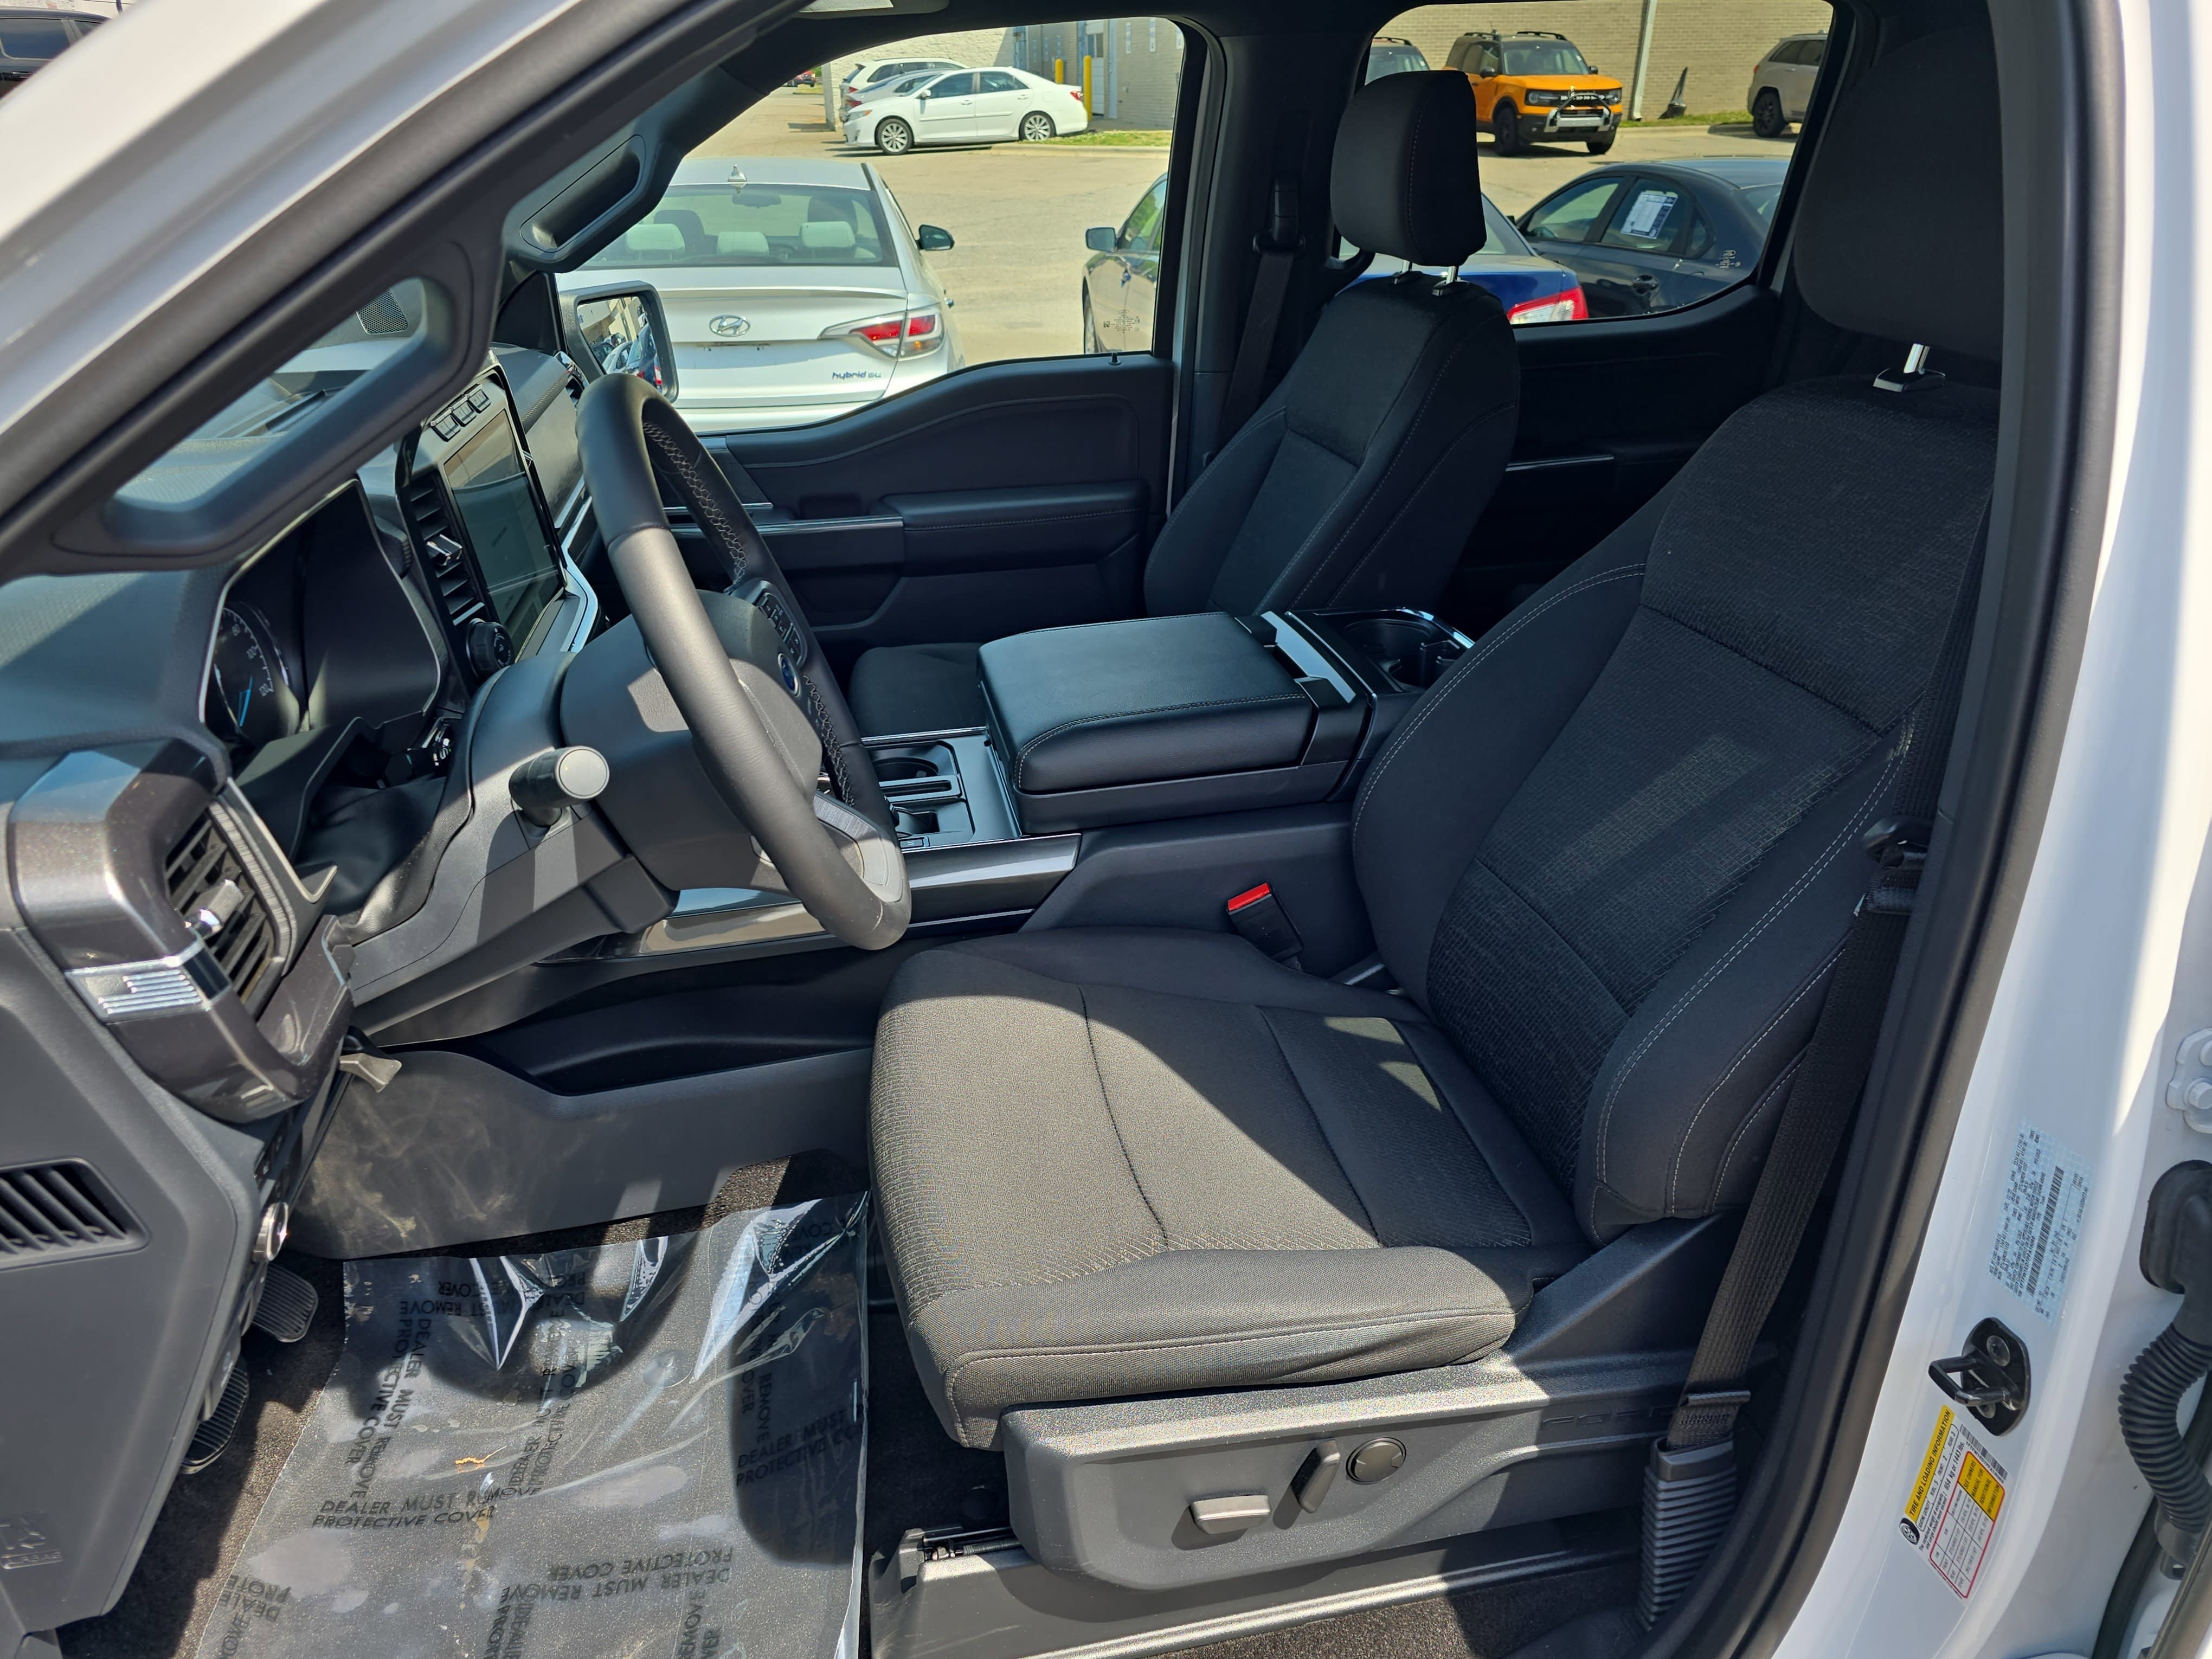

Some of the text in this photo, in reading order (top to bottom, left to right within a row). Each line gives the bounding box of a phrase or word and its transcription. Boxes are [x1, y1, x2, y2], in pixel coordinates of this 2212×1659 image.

[832, 370, 866, 380] hybrid
[400, 1300, 462, 1316] REMOVE
[350, 1319, 431, 1498] DEALER MUST REMOVE
[757, 1373, 772, 1443] REMOVE
[345, 1416, 379, 1465] COVER
[1909, 1409, 1951, 1517] TIRE AND LOADING INFORMATION
[1951, 1463, 1956, 1472] or
[1952, 1449, 1961, 1465] 1443
[1966, 1459, 1976, 1481] OWNERS
[1947, 1468, 1955, 1481] kg
[1970, 1477, 1980, 1498] MANUAL
[320, 1500, 391, 1515] DEALER
[402, 1491, 455, 1512] MUST
[1978, 1476, 1991, 1506] ADDITIONAL
[1986, 1482, 2000, 1515] INFORMATION
[311, 1506, 494, 1529] PROTECTIVE COVER
[548, 1547, 734, 1581] PROTECTIVE COVER
[224, 1575, 292, 1604] PROTE
[501, 1567, 730, 1604] DEALER MUST REMOVE
[217, 1592, 281, 1623] DEALE
